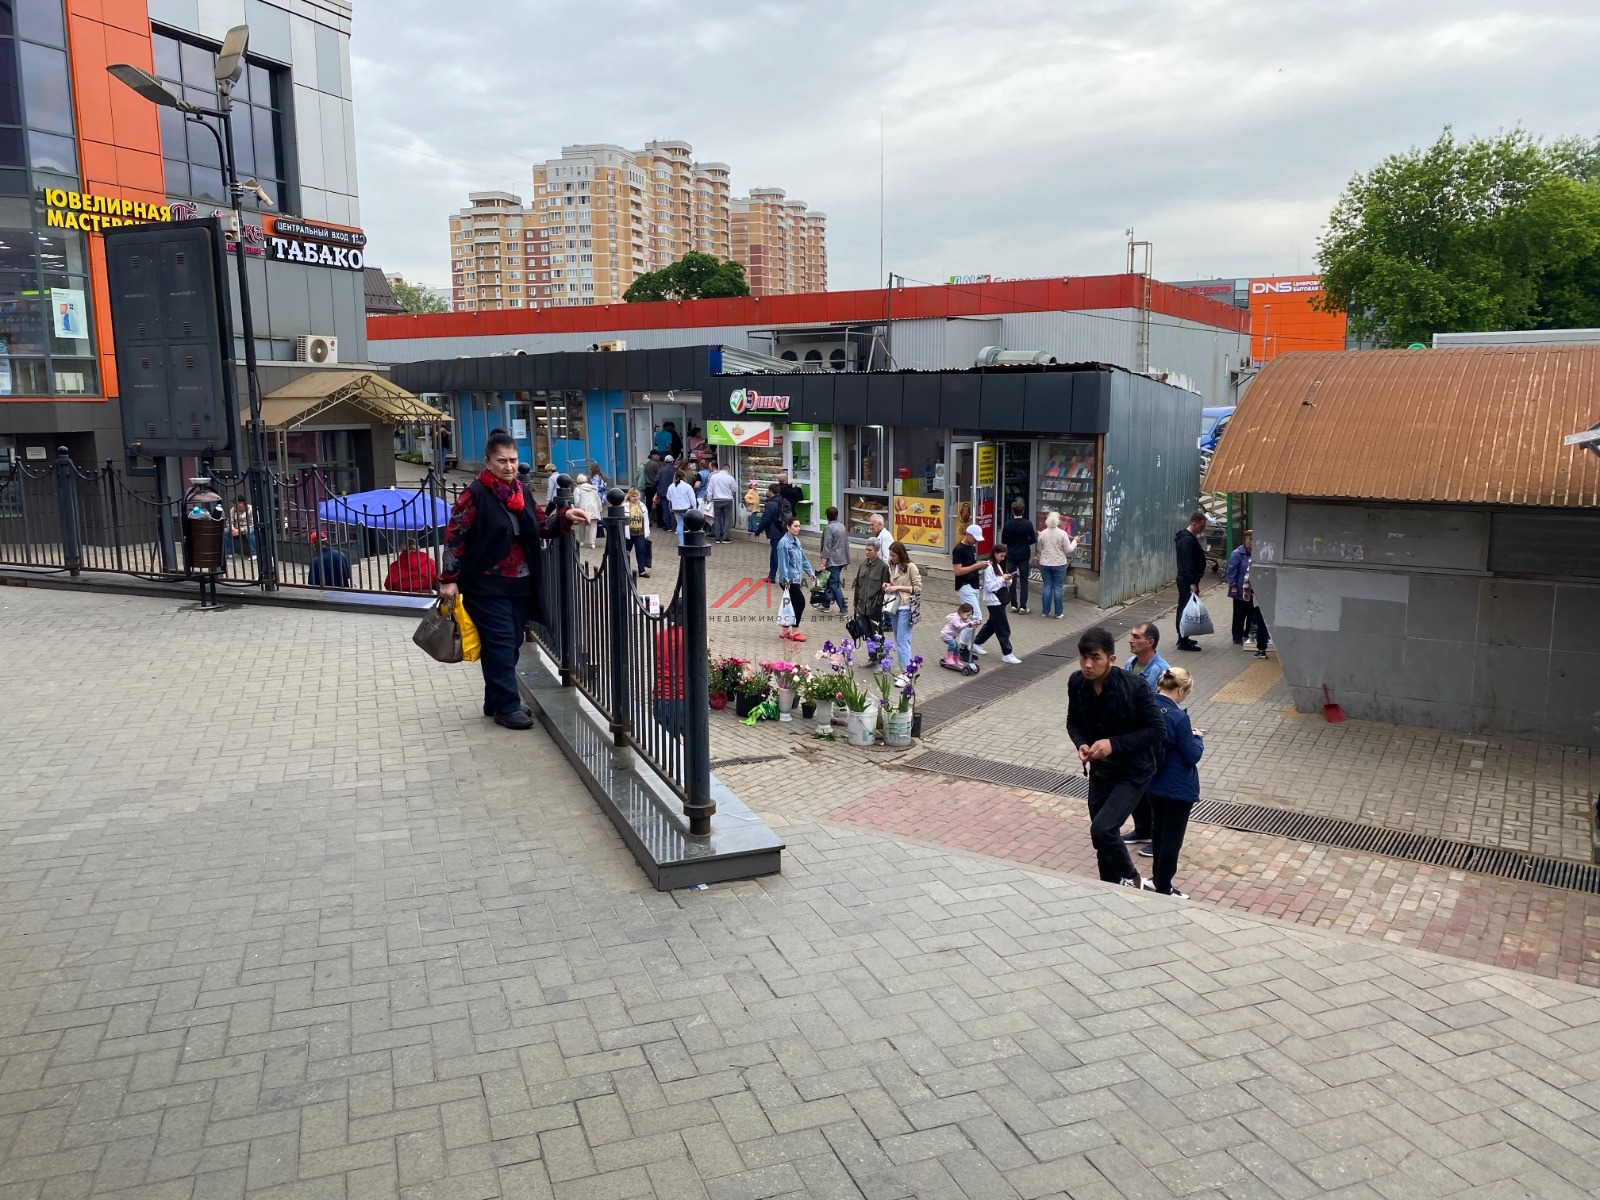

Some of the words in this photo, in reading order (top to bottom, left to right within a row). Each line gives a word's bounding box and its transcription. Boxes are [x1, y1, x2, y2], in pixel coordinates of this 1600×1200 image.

[45, 187, 171, 222] ЮВЕЛИРНАЯ
[277, 221, 329, 238] ЦЕНТРАЛЬНЫЙ
[331, 231, 349, 242] ВХОД
[1252, 281, 1292, 294] DNS
[895, 514, 942, 529] ВЫПЕЧКА
